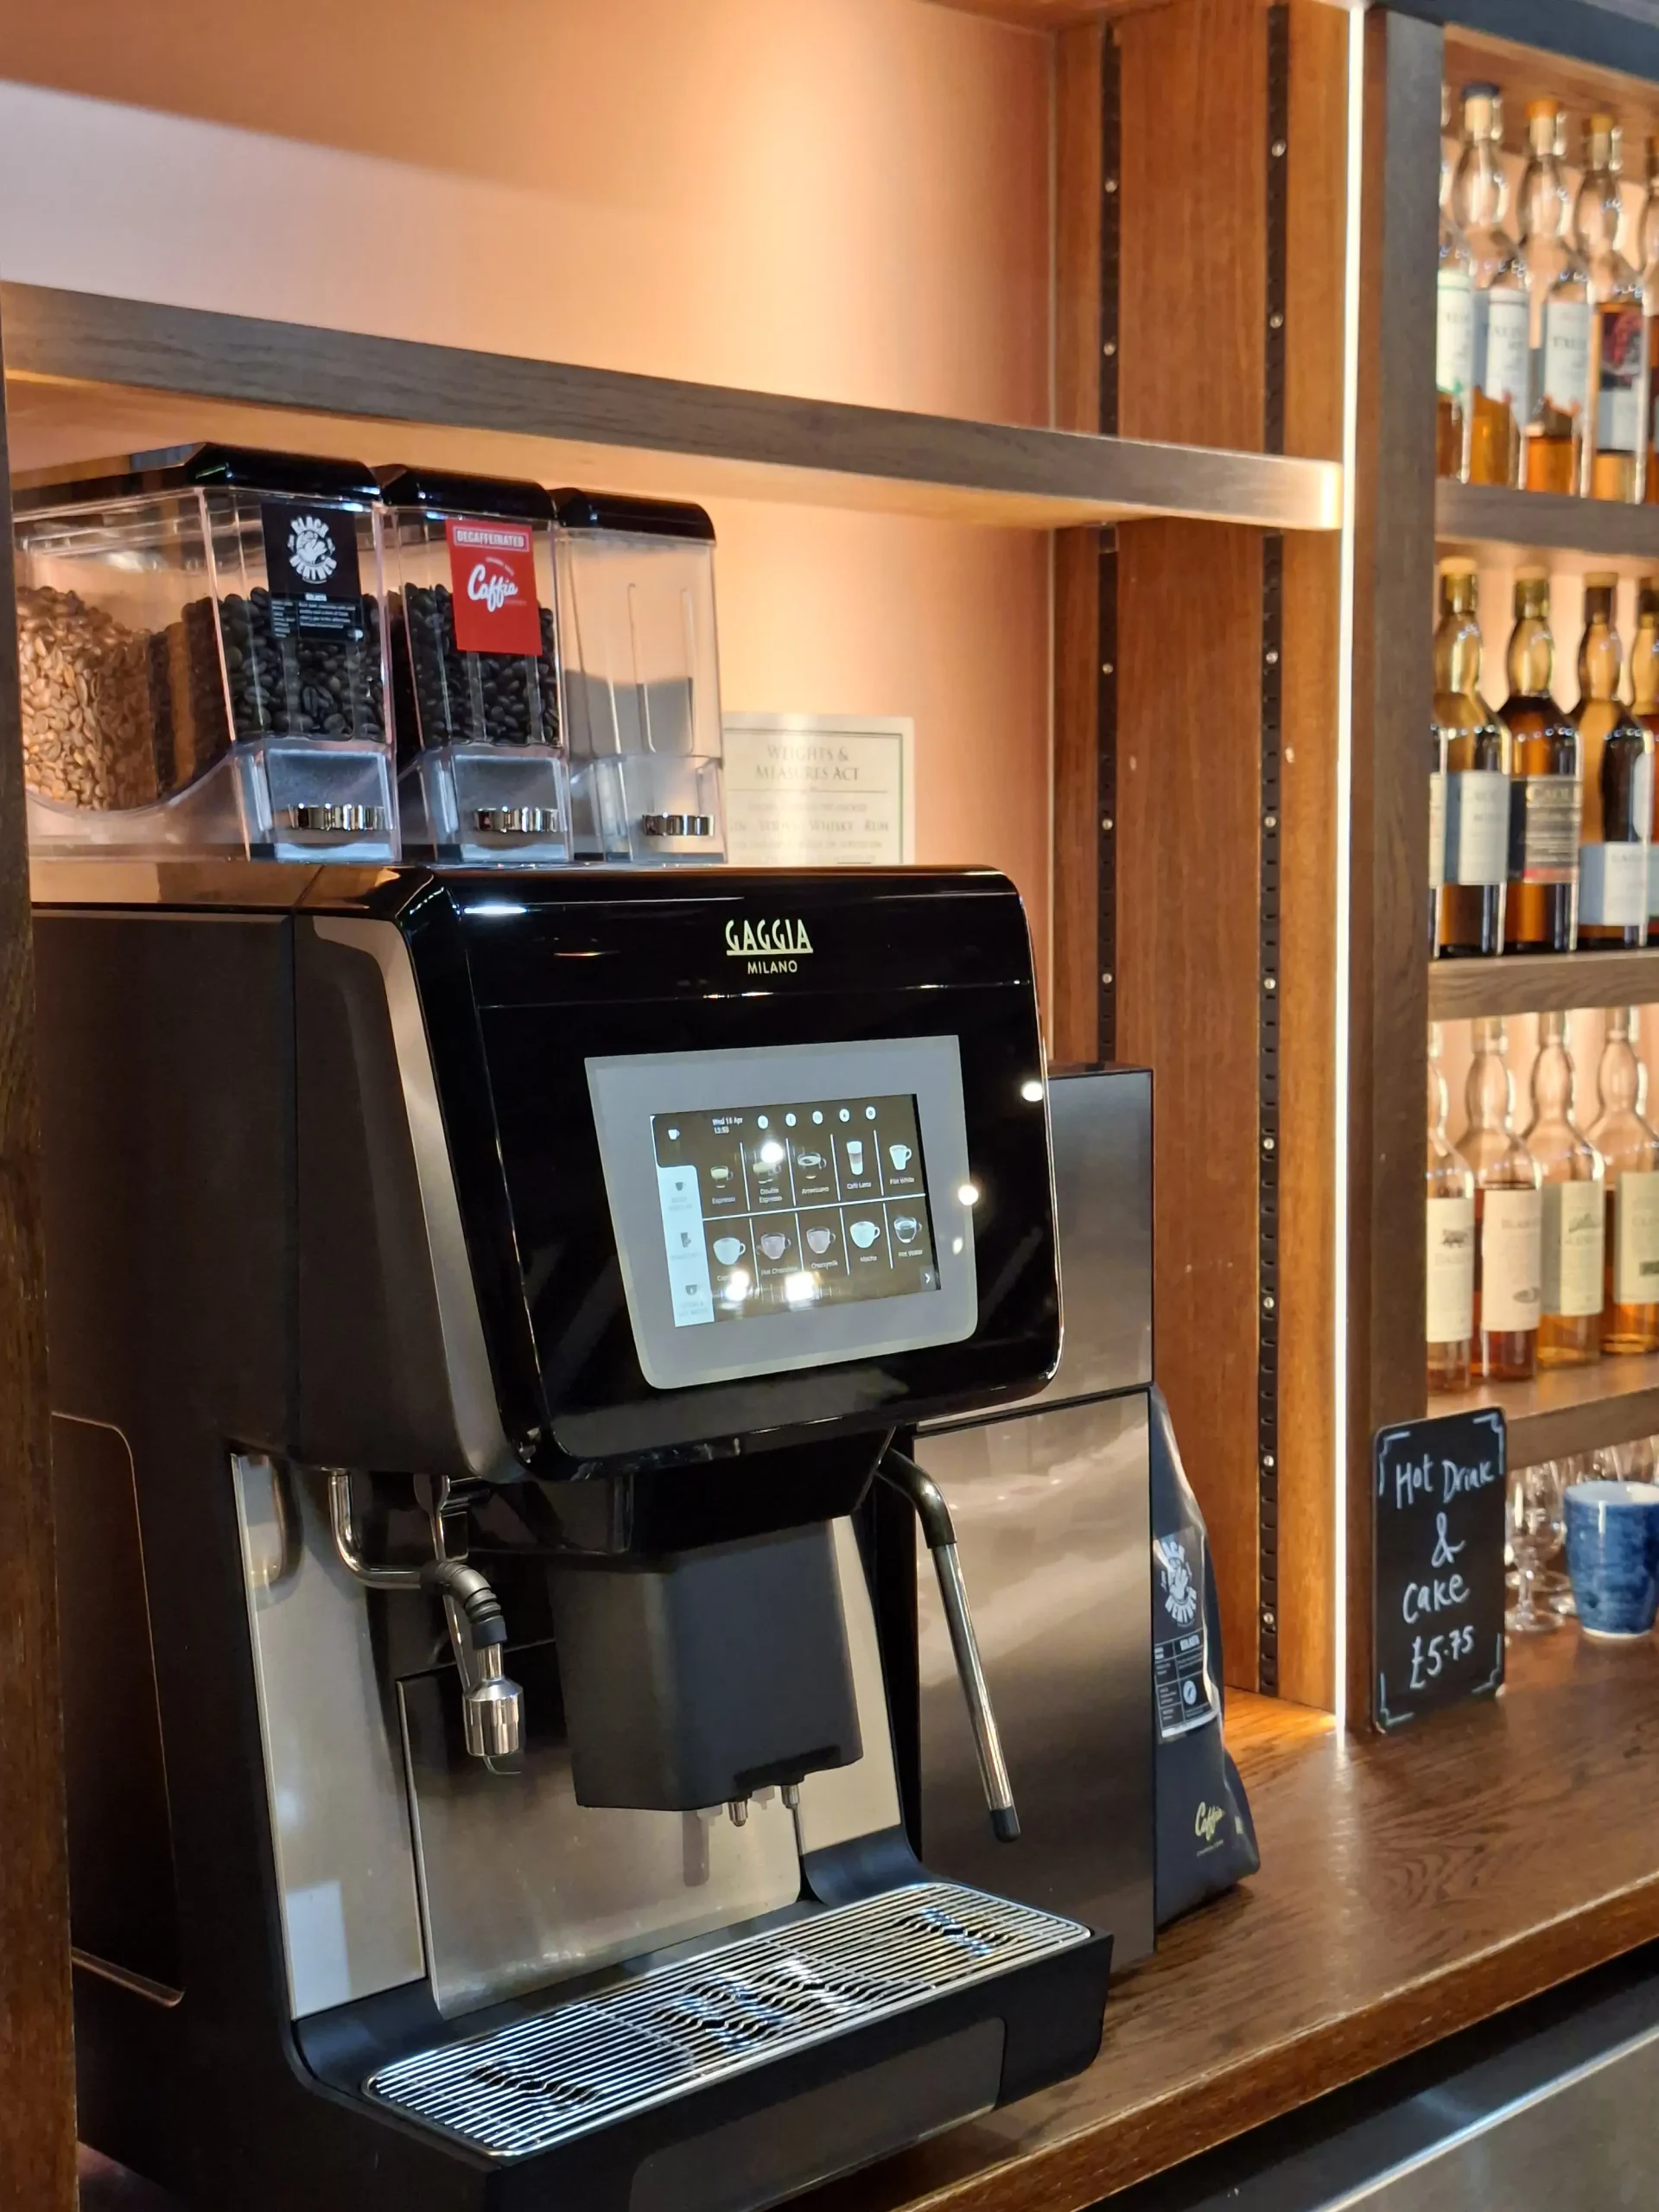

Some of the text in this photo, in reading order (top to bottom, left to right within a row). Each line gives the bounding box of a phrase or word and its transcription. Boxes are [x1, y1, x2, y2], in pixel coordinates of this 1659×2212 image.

[456, 530, 524, 548] DECAFFEINATED
[766, 744, 849, 762] WEIGHTS &
[755, 765, 860, 781] MEASURES ACT
[725, 918, 813, 954] GAGGIA
[747, 960, 798, 975] MILANO
[1395, 1453, 1433, 1510] Hot
[1431, 1511, 1466, 1568] &
[1402, 1573, 1470, 1624] Cake
